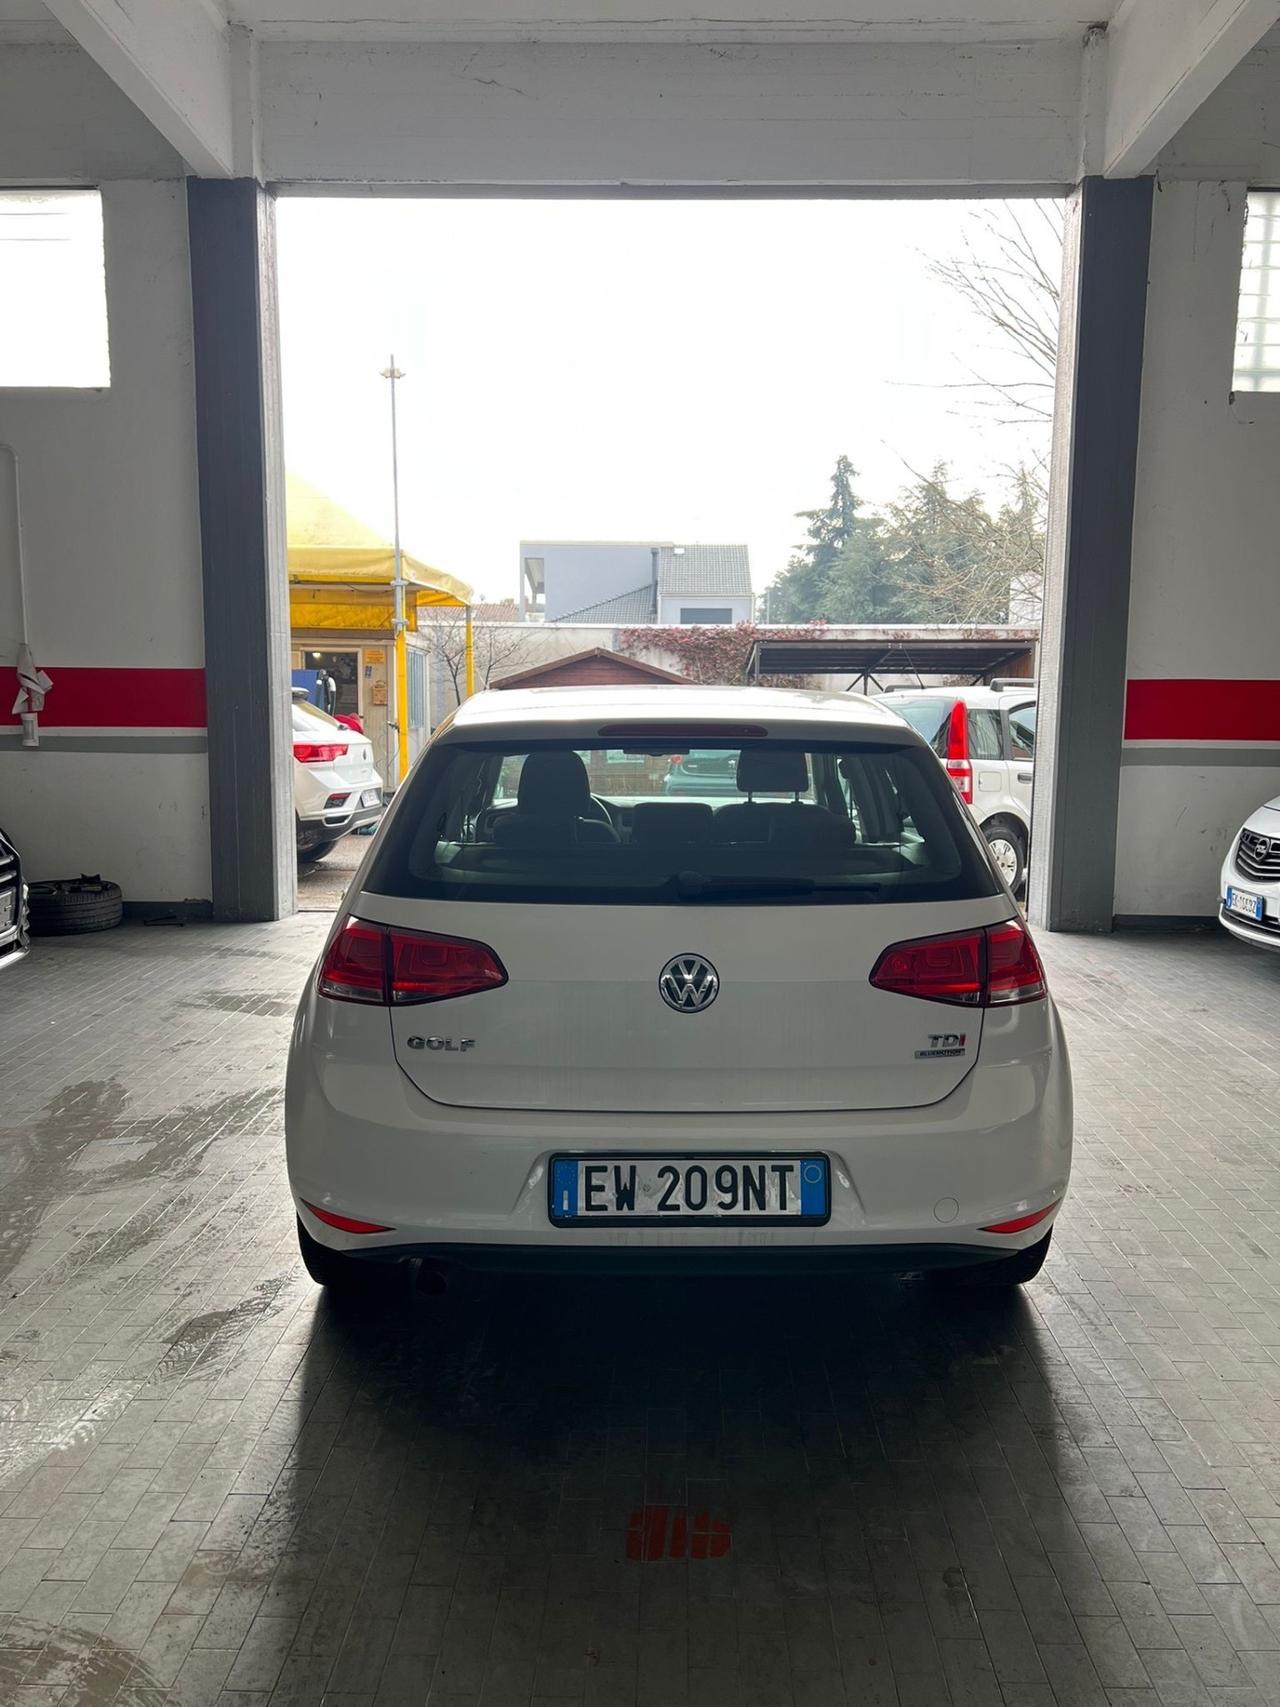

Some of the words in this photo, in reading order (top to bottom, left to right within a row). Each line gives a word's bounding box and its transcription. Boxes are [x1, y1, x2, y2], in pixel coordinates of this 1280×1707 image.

[407, 1036, 476, 1052] GOLF
[584, 1165, 636, 1211] EW
[657, 1164, 794, 1211] 209NT
